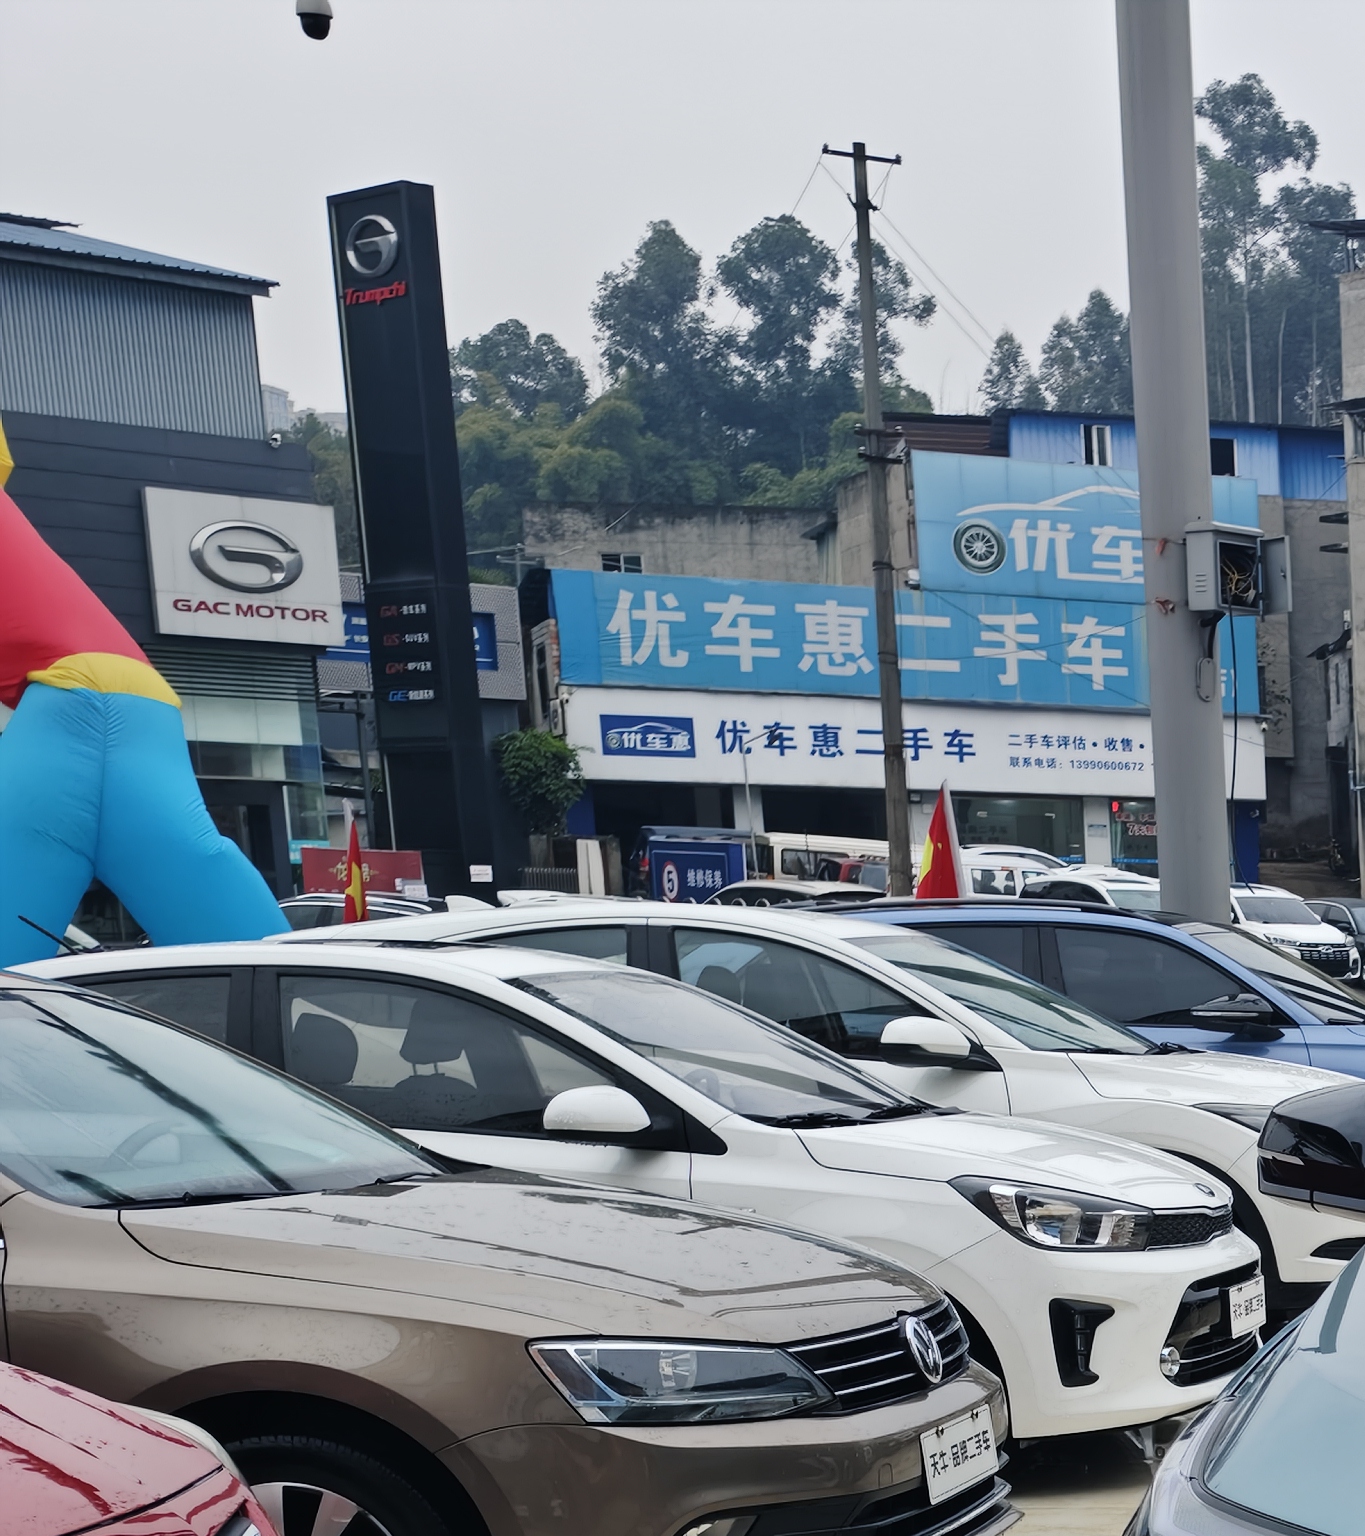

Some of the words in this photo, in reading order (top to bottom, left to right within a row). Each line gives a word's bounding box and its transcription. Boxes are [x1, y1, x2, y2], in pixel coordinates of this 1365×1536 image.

[345, 281, 407, 306] Trumpchi
[172, 598, 231, 615] GAC
[235, 603, 329, 623] MOTOR
[606, 589, 1129, 691] 优车惠二手车
[620, 731, 691, 751] 优车惠
[715, 719, 976, 763] 优车惠二手车
[666, 870, 675, 893] 5
